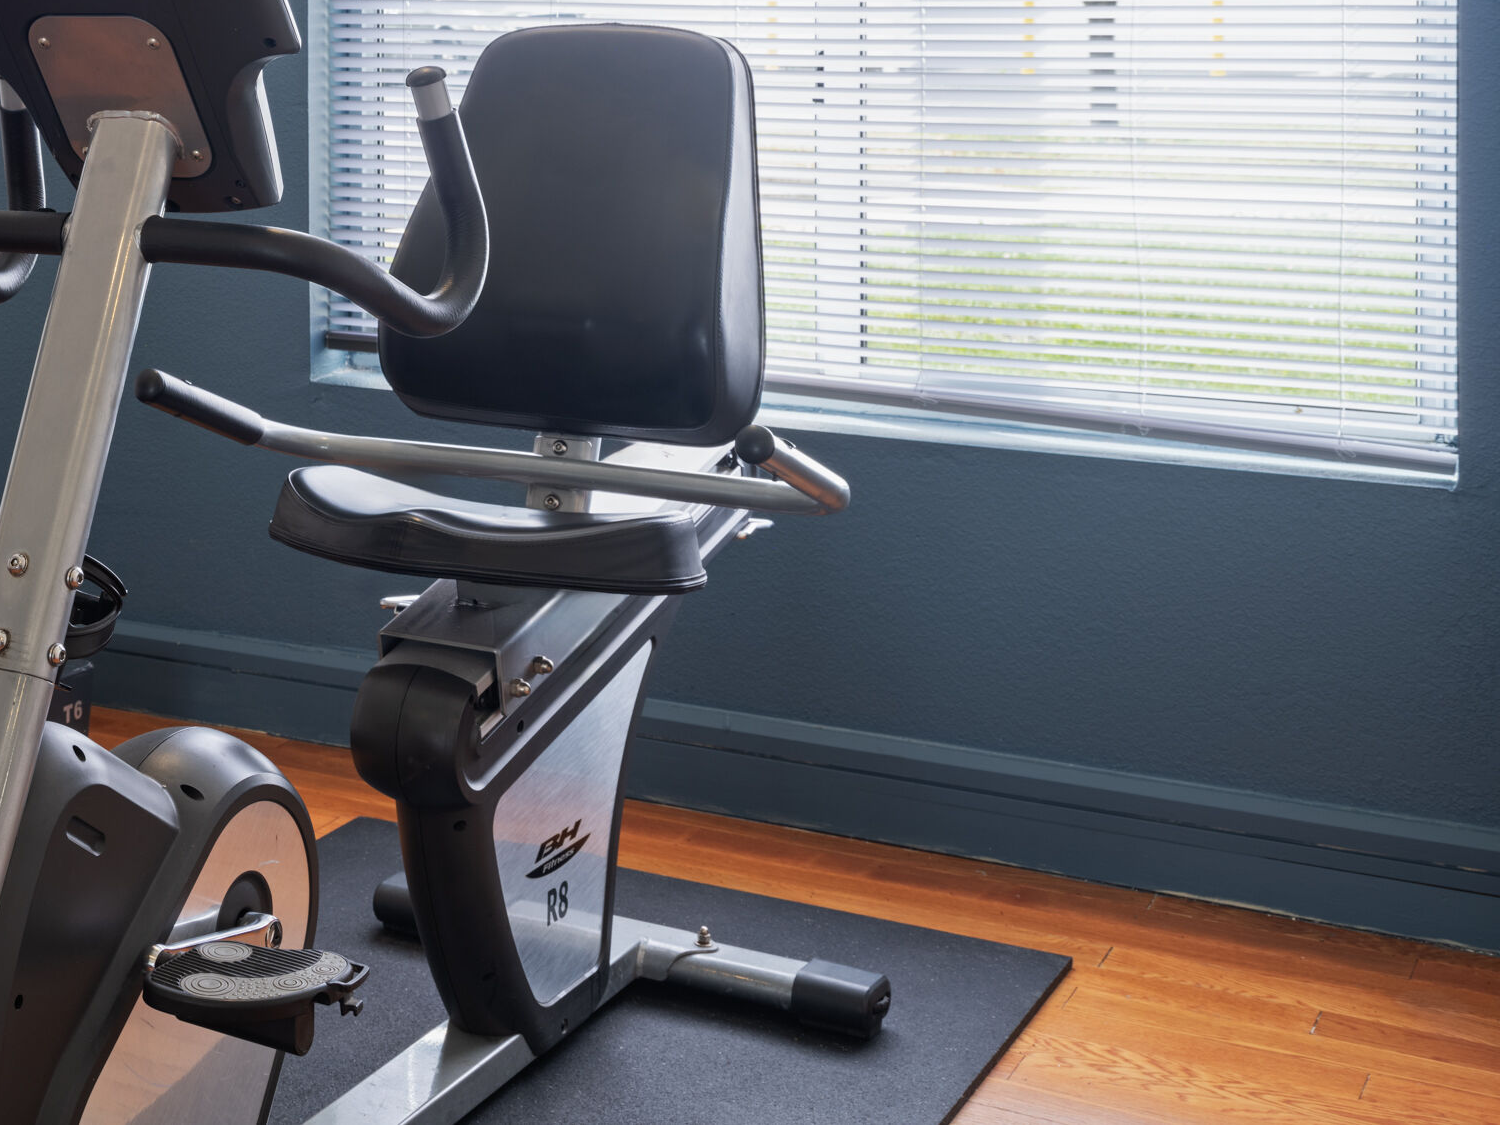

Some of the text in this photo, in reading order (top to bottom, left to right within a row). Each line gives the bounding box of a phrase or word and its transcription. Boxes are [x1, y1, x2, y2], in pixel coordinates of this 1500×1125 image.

[62, 699, 83, 724] T6
[535, 818, 582, 864] BH
[542, 847, 576, 874] Fitness
[546, 880, 569, 927] R8
